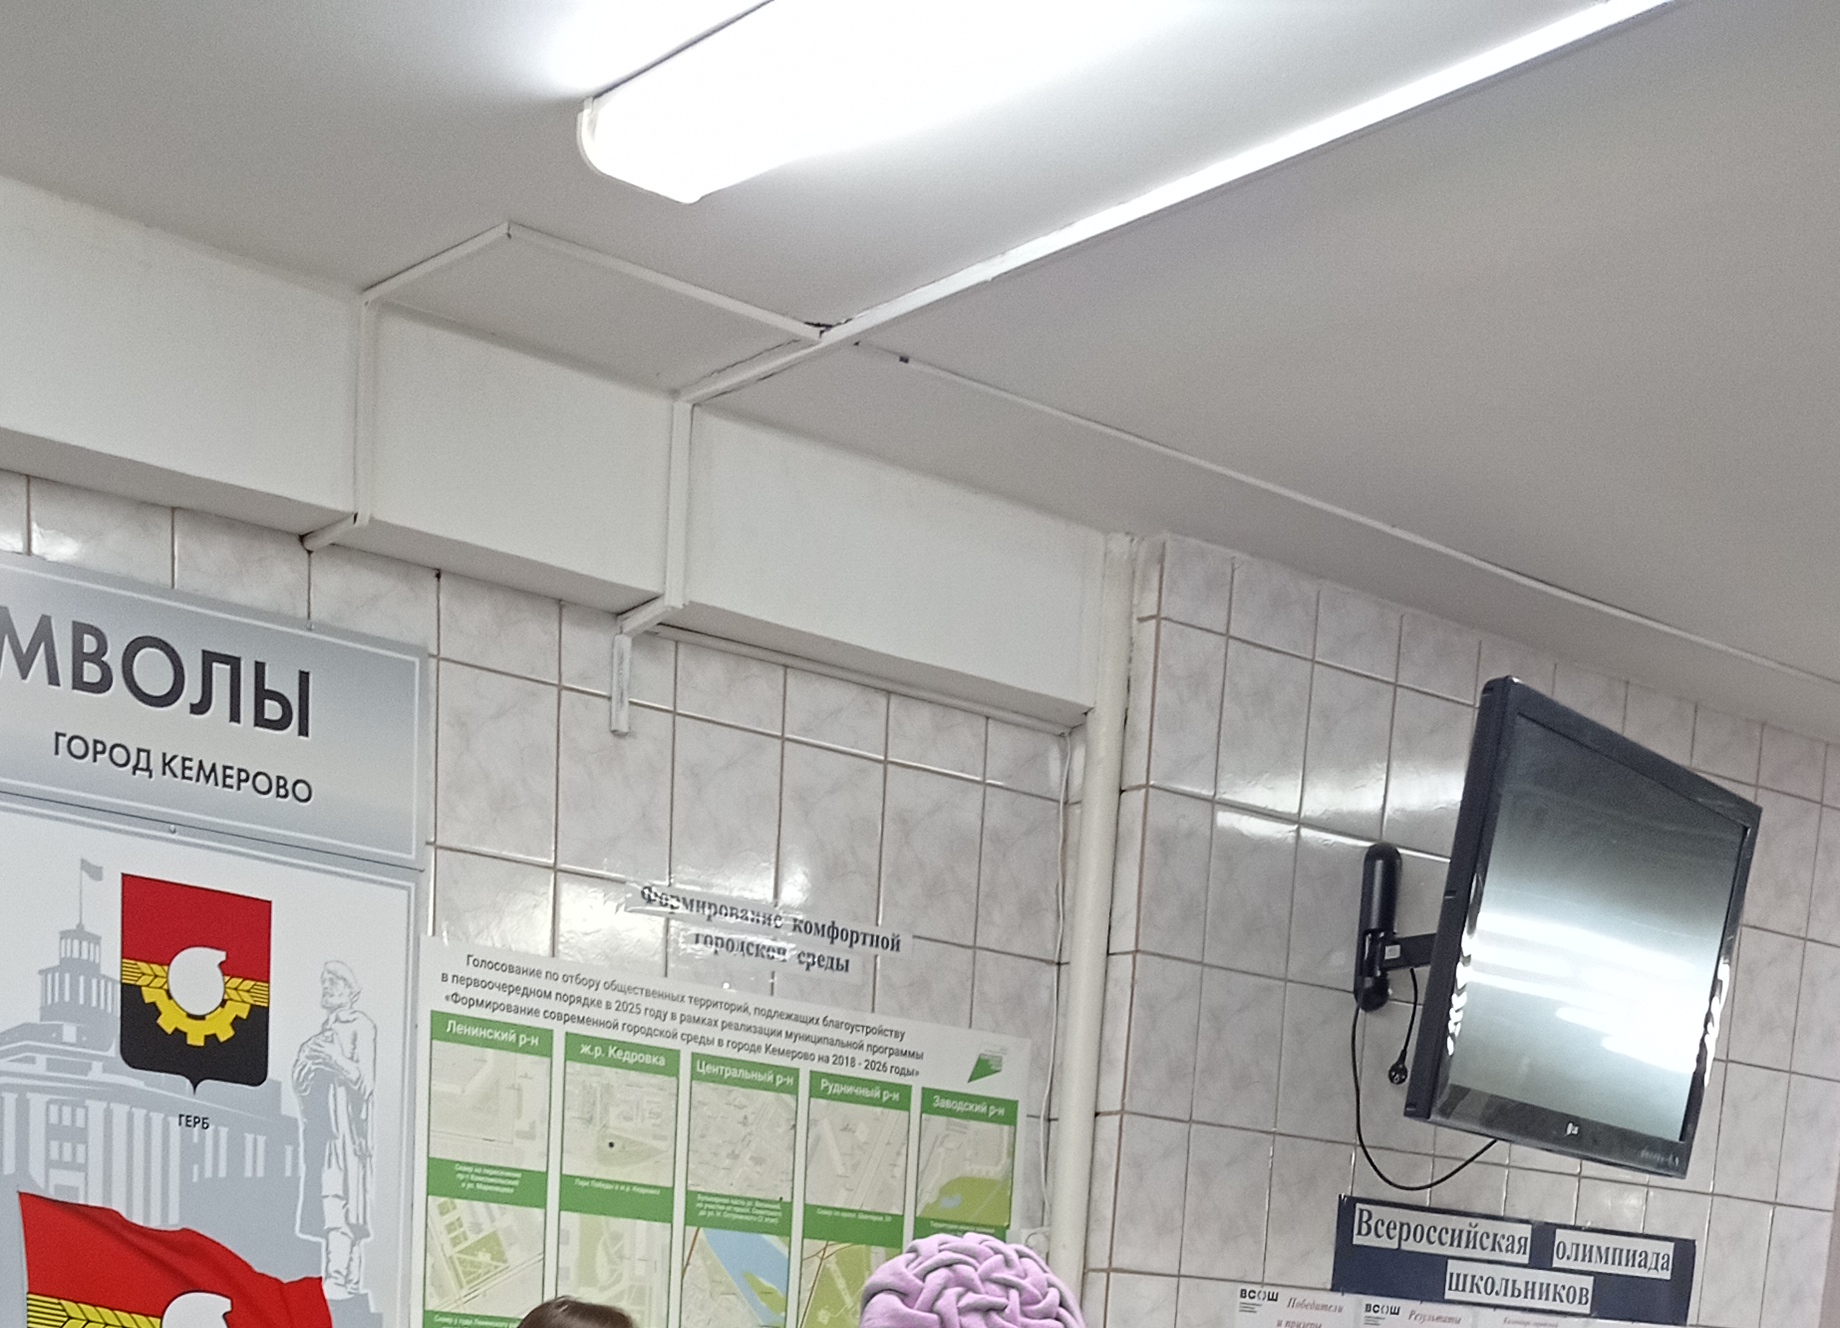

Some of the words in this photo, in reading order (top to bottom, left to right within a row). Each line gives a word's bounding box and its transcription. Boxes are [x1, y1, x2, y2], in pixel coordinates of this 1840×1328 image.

[54, 731, 153, 779] ГОРОД
[162, 752, 313, 803] КЕМЕРОВО
[792, 918, 901, 952] комфортной
[797, 950, 849, 972] среды
[466, 954, 542, 979] Голосование
[545, 969, 559, 981] по
[562, 973, 600, 991] отбору
[603, 979, 685, 1003] общественных
[688, 996, 752, 1016] территорий,
[754, 1006, 820, 1026] подлежащих
[822, 1015, 905, 1042] благоустройству
[441, 972, 449, 982] в
[451, 973, 552, 1000] первоочередном
[555, 991, 603, 1009] порядке
[605, 1001, 612, 1010] в
[615, 1000, 642, 1015] 2025
[644, 1008, 668, 1022] году
[670, 1011, 677, 1021] в
[680, 1013, 719, 1028] рамках
[721, 1020, 782, 1039] реализации
[785, 1031, 864, 1051] муниципальной
[866, 1043, 924, 1060] программы
[445, 992, 541, 1018] «Формирование
[543, 1009, 619, 1031] современной
[622, 1021, 678, 1040] городской
[680, 1032, 715, 1046] среды
[717, 1038, 724, 1048] в
[726, 1039, 762, 1055] городе
[765, 1043, 815, 1062] Кемерово
[817, 1053, 830, 1064] на
[832, 1054, 856, 1068] 2018
[864, 1059, 888, 1073] 2026
[890, 1064, 920, 1078] годы»
[446, 1020, 517, 1043] Ленинский
[519, 1032, 540, 1047] р-н
[580, 1042, 605, 1058] ж.р.
[608, 1045, 666, 1067] Кедровка
[697, 1060, 774, 1084] Центральный
[776, 1072, 794, 1086] р-н
[820, 1079, 881, 1100] Рудничный
[883, 1089, 900, 1103] р-н
[933, 1095, 987, 1114] Заводский
[989, 1103, 1005, 1118] р-н
[178, 1113, 210, 1131] ГЕРБ
[1355, 1208, 1529, 1257] Всероссийская
[1555, 1238, 1671, 1273] олимпиада
[1448, 1271, 1590, 1306] школьников
[1287, 1297, 1345, 1314] Победители
